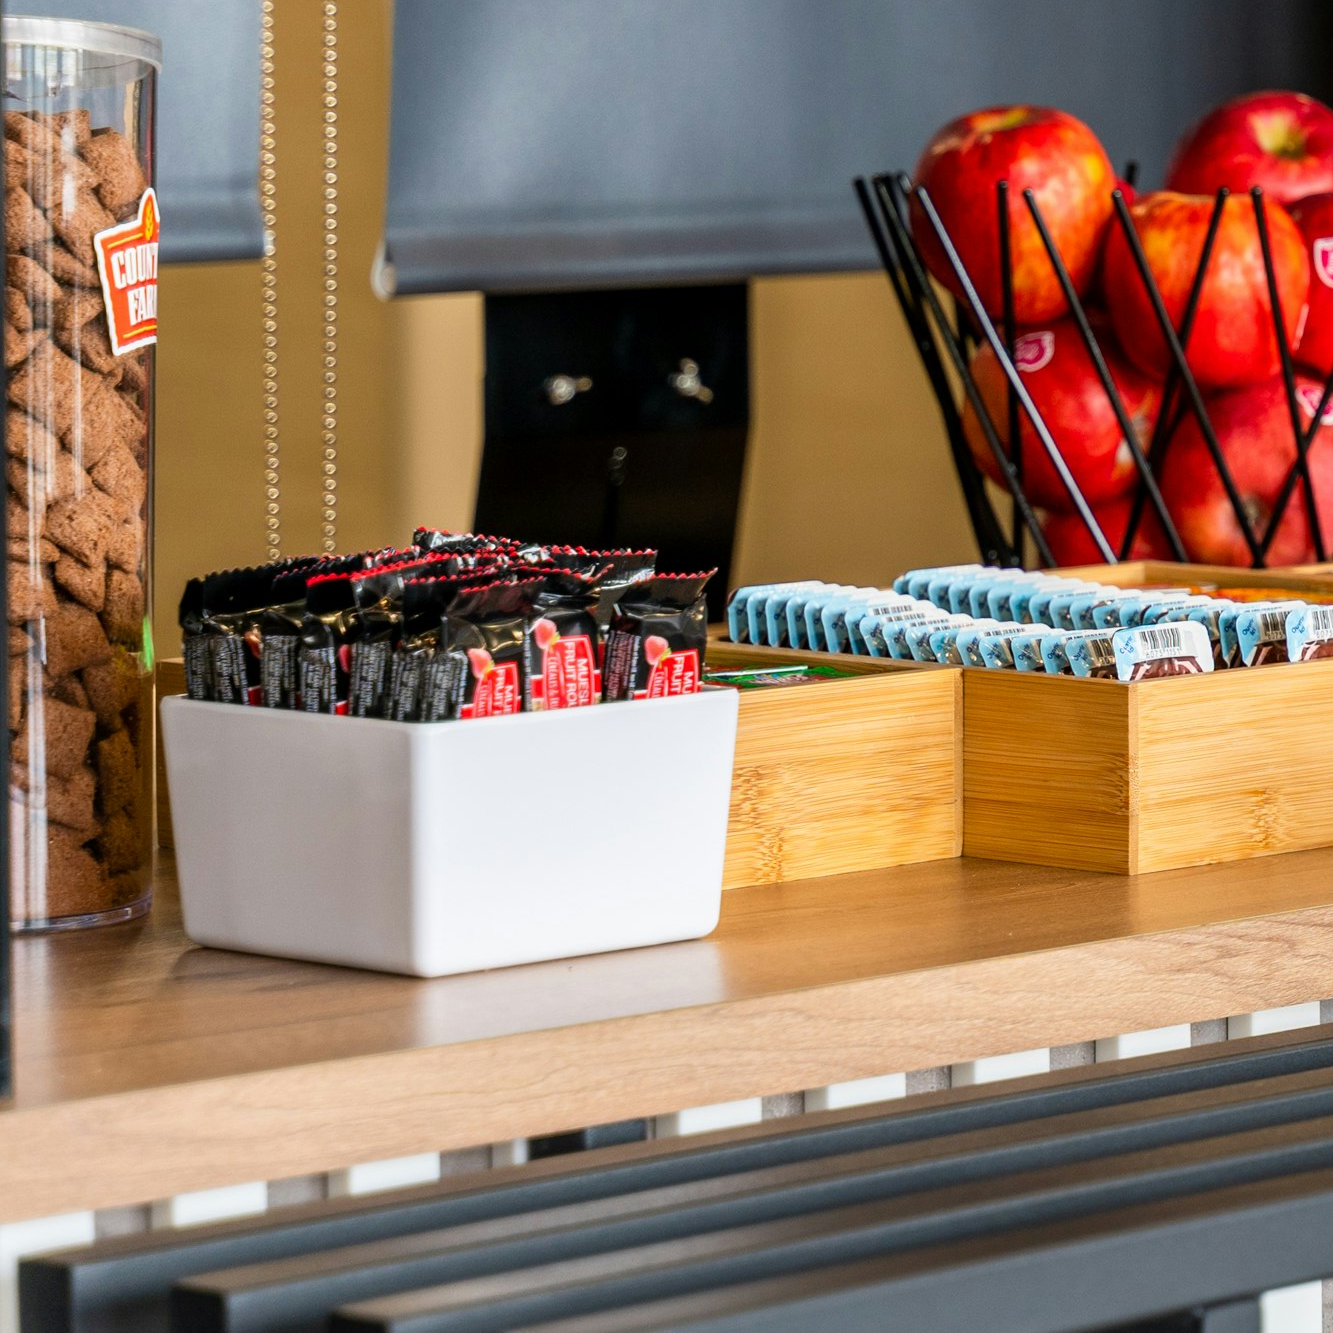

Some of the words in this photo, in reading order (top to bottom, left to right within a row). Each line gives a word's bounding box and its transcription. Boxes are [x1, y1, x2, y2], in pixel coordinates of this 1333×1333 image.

[564, 641, 577, 680] FRUIT
[670, 656, 685, 694] FRUIT
[493, 669, 506, 705] FRUIT
